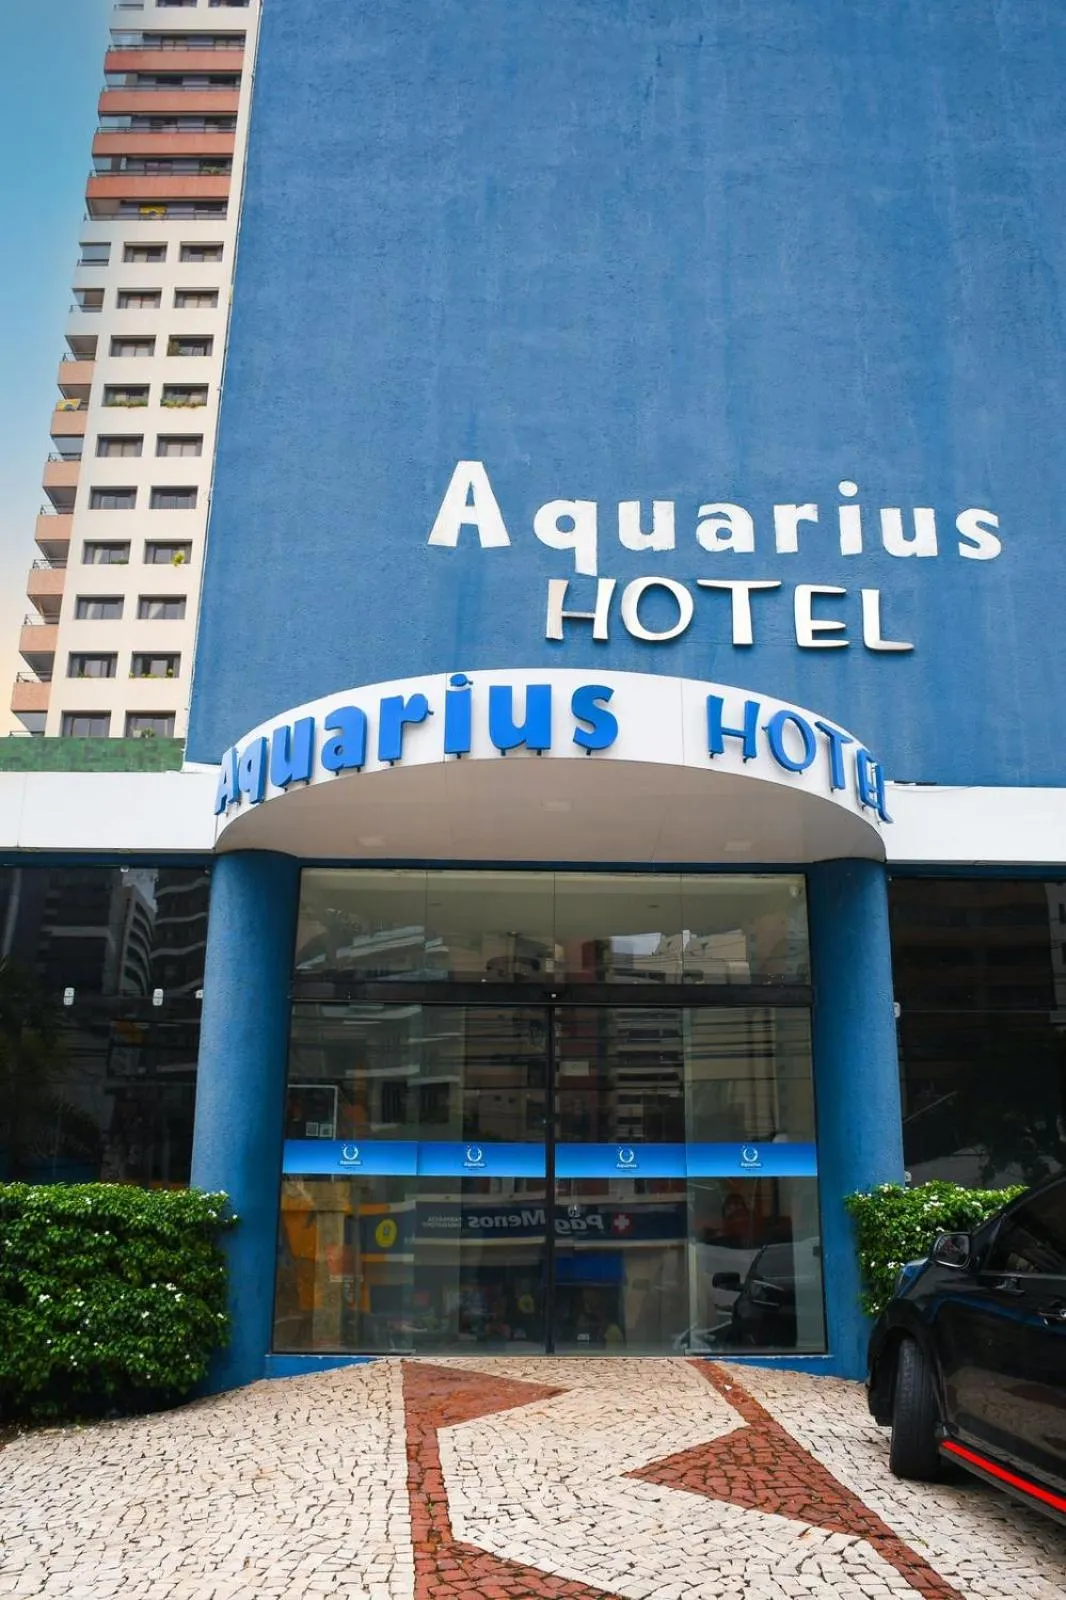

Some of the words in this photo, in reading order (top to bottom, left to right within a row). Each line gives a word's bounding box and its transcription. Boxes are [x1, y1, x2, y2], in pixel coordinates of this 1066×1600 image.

[427, 460, 1003, 577] Aquarius
[545, 576, 915, 651] HOTEL
[214, 673, 619, 815] Aquarius
[706, 694, 893, 824] HOTEL
